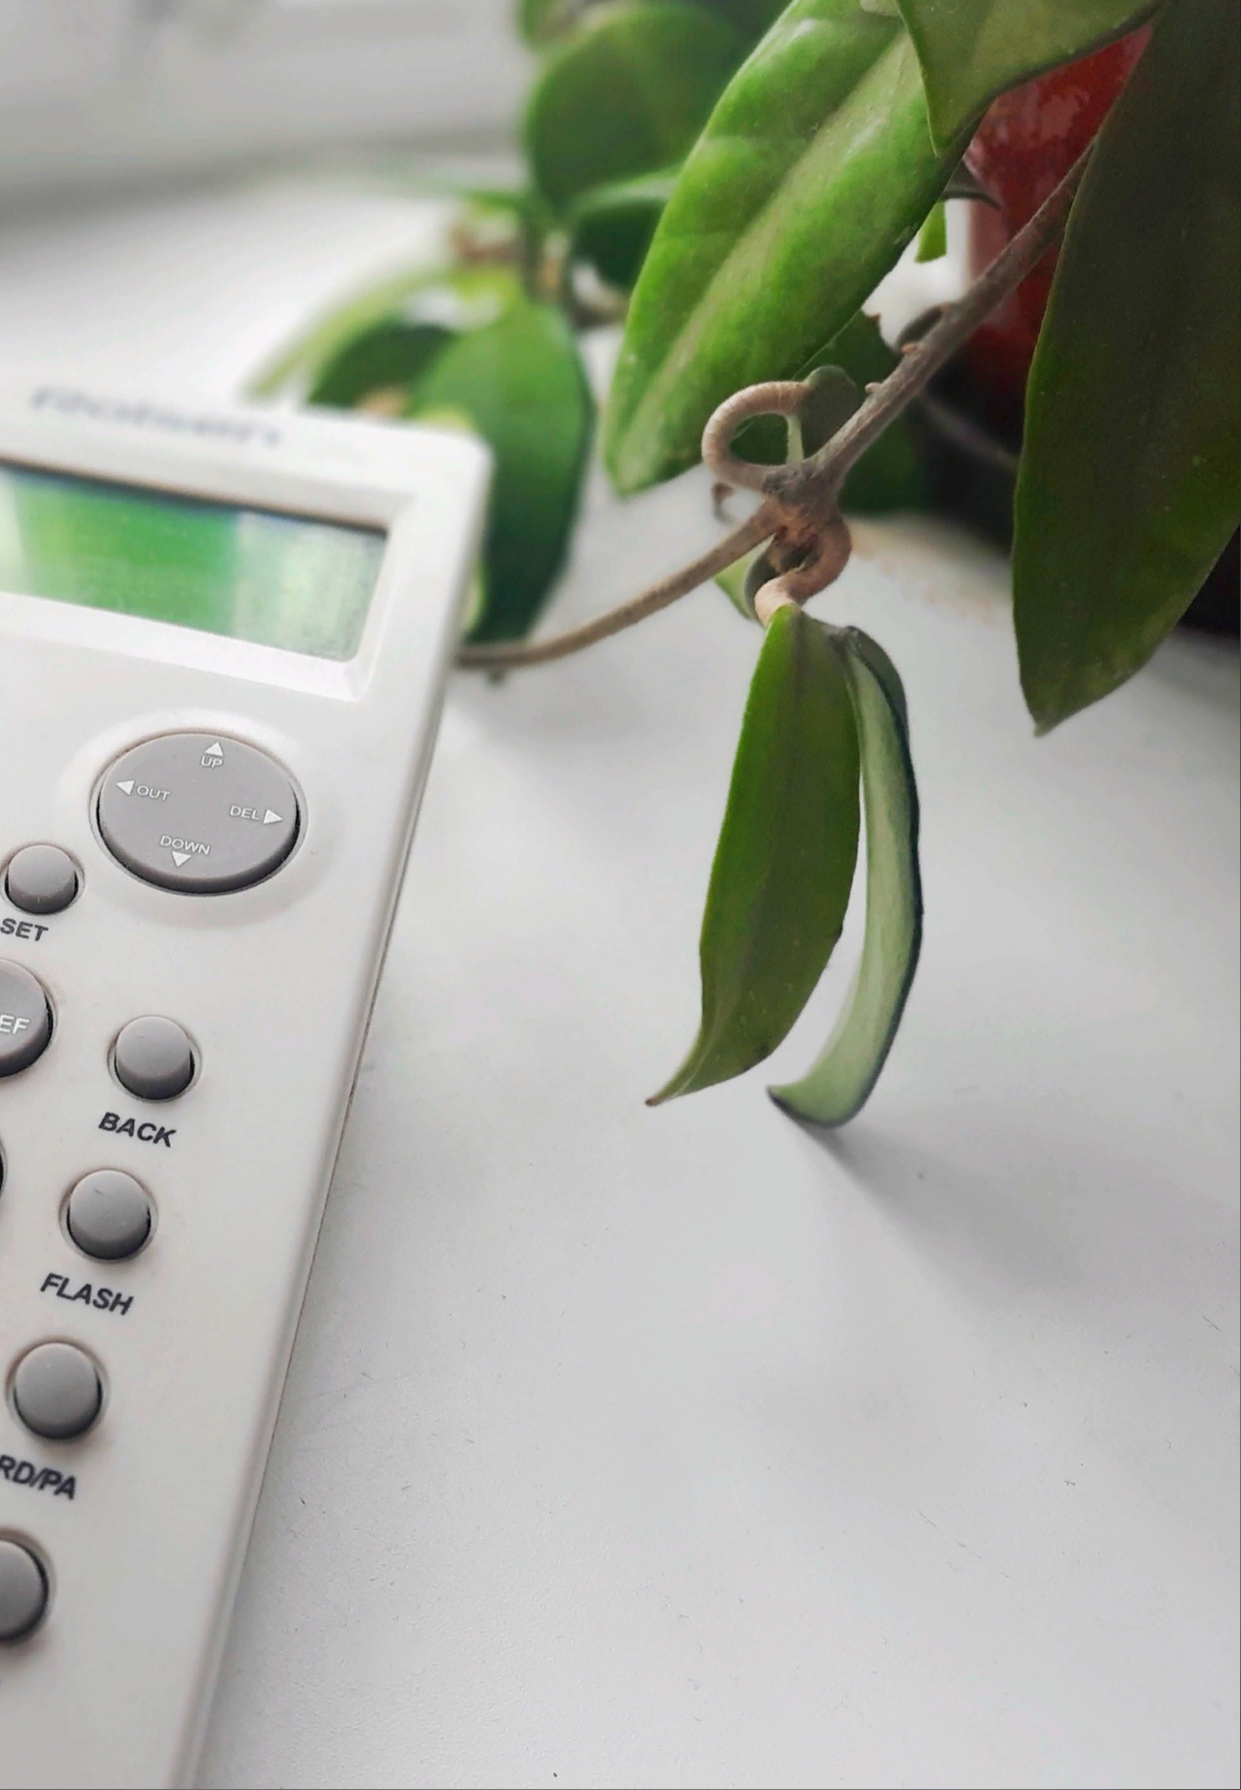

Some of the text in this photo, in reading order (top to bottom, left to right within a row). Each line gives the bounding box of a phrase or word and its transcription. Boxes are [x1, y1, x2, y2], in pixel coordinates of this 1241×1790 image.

[201, 756, 223, 768] UP
[136, 785, 171, 801] OUT
[229, 805, 260, 821] DEL
[160, 835, 210, 855] DOWN
[0, 918, 49, 942] SET
[98, 1111, 177, 1148] BACK
[40, 1272, 134, 1316] FLASH
